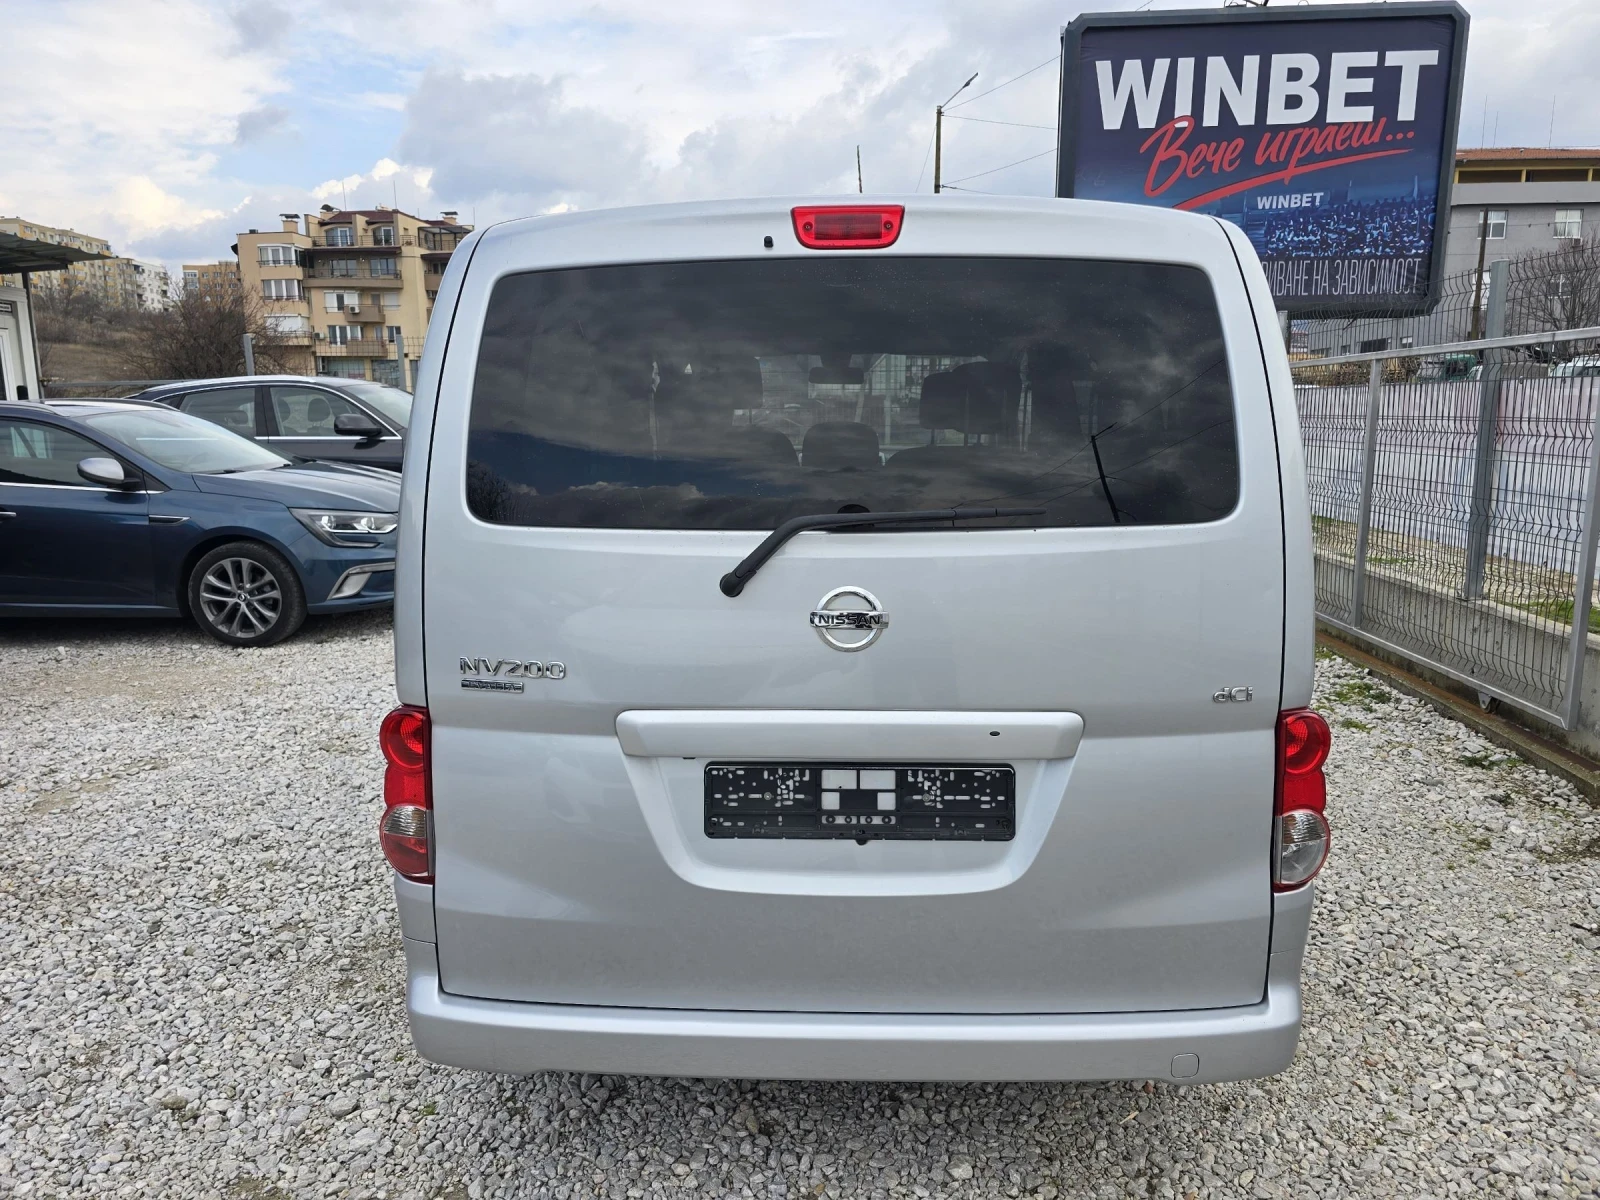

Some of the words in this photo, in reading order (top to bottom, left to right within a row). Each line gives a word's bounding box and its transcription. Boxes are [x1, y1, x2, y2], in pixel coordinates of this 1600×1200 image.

[1095, 50, 1439, 130] WINBET
[1140, 115, 1245, 197] Вече
[1257, 192, 1324, 209] WINBET
[1312, 259, 1329, 296] НА
[1332, 257, 1422, 296] ЗАВИСИМОСТ
[818, 614, 881, 625] NISSAN
[459, 656, 567, 680] NV200
[1212, 686, 1254, 704] dCi
